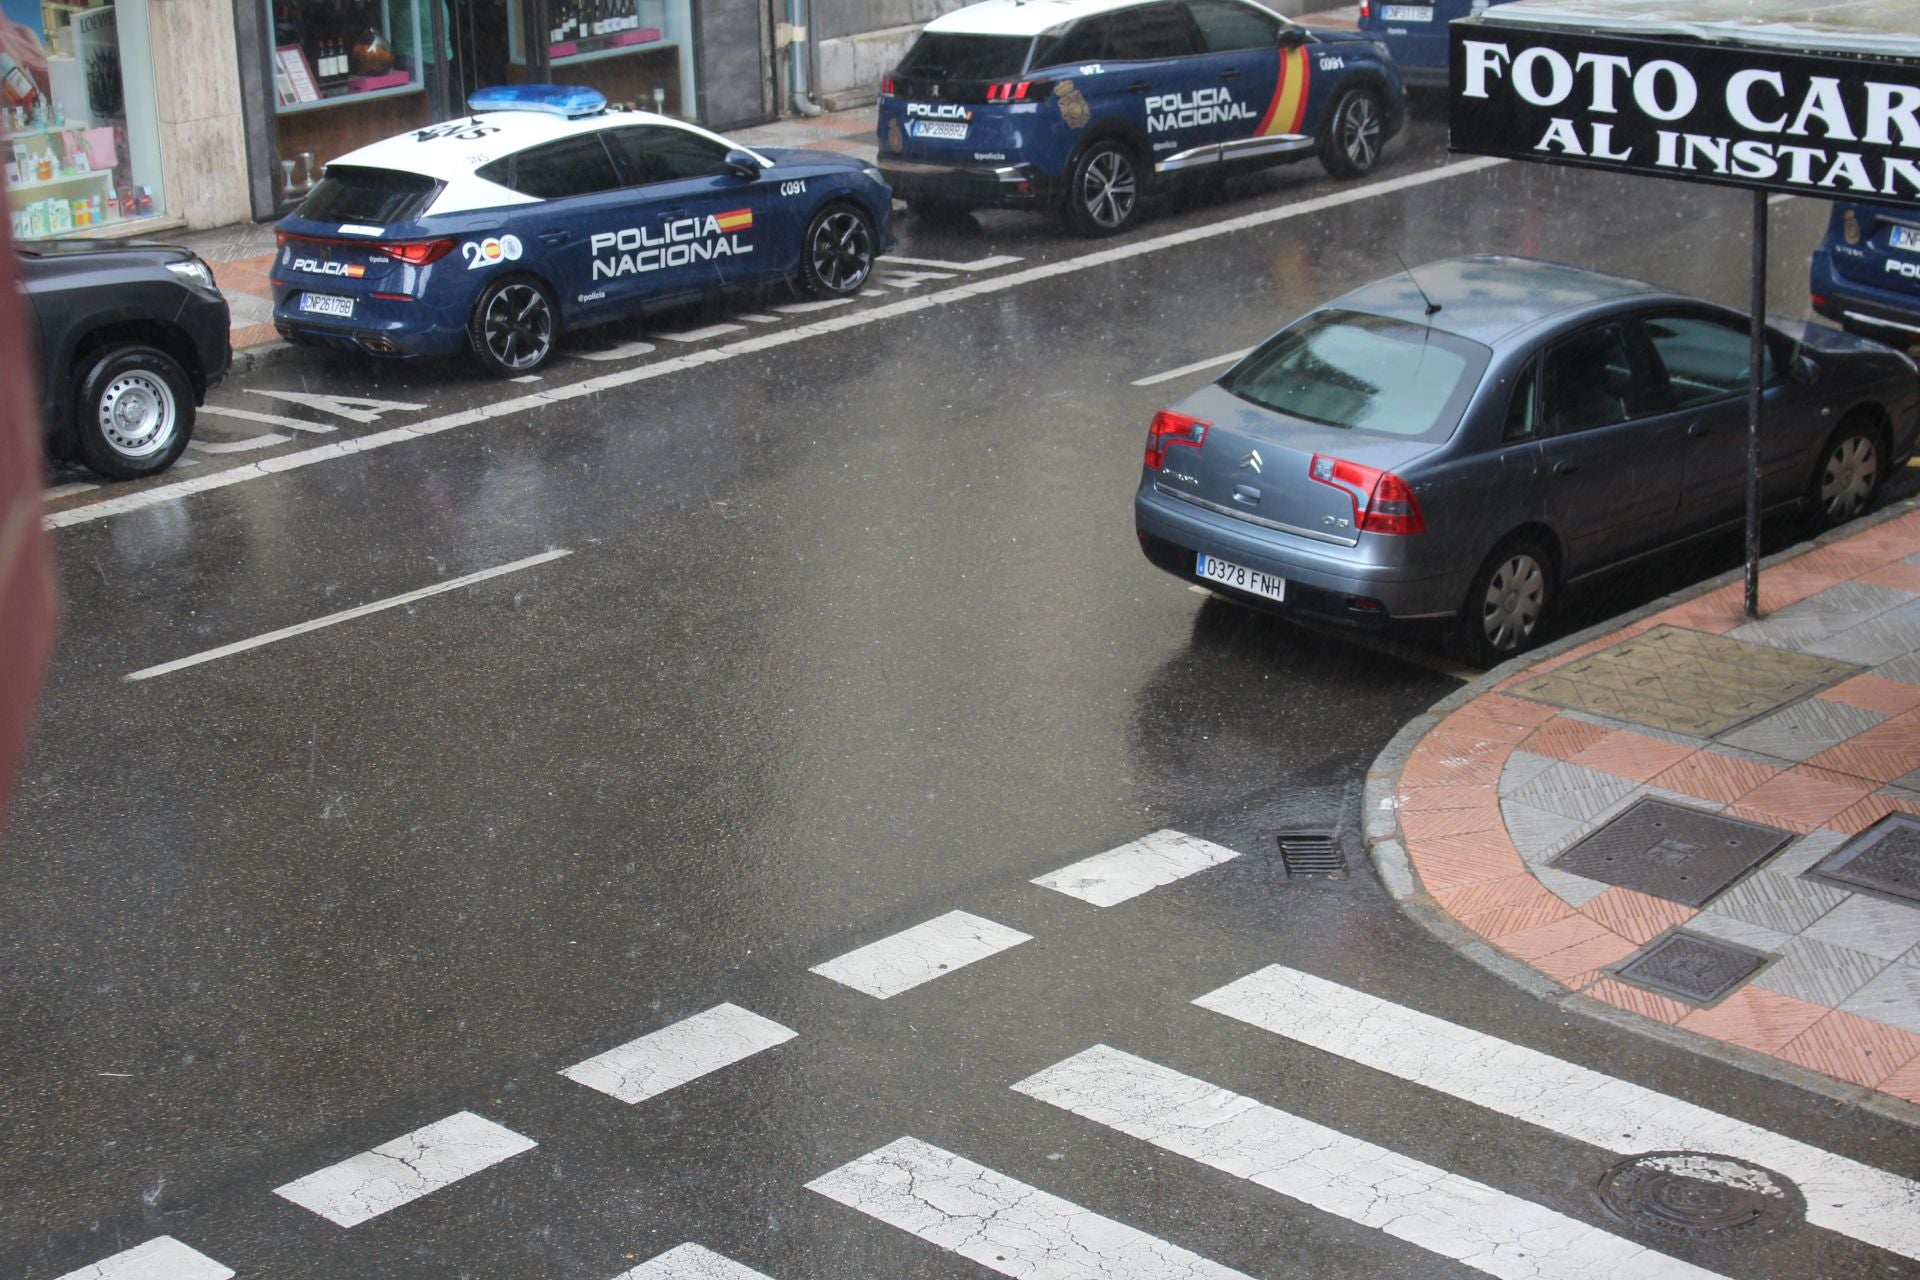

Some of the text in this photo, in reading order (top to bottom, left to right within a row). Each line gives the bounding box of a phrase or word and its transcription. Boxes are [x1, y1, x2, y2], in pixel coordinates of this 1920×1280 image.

[1462, 40, 1920, 149] FOTO CAR
[1147, 101, 1257, 133] NACIONAL
[1533, 117, 1633, 162] AL
[780, 180, 806, 197] C091
[592, 234, 753, 281] NACIONAL
[1207, 558, 1281, 597] 0378 FNH
